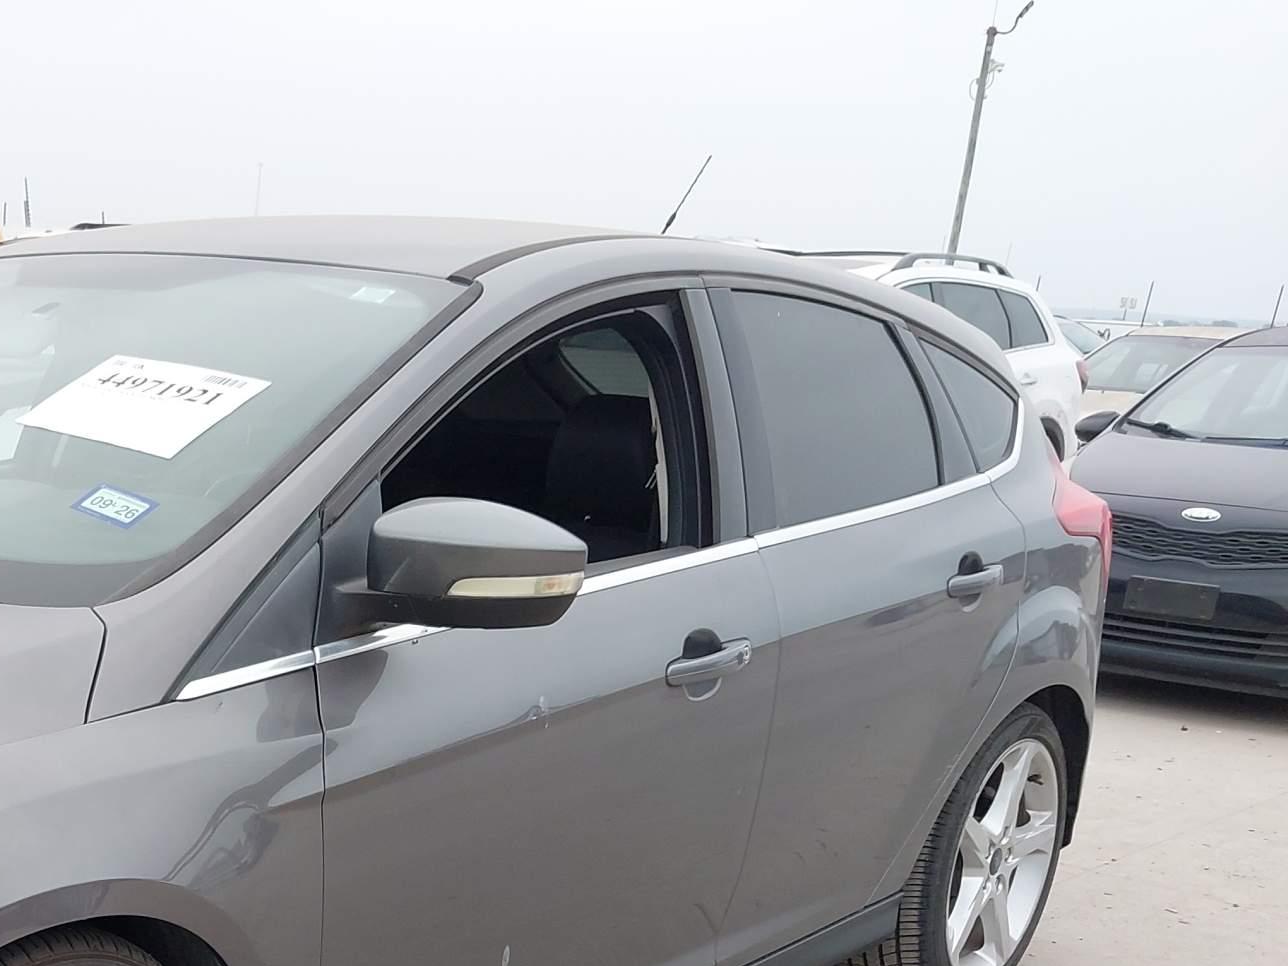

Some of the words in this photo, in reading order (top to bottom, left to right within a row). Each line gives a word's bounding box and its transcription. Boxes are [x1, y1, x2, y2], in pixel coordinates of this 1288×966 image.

[97, 372, 223, 405] 44971921
[90, 495, 113, 509] 09
[113, 505, 139, 519] 26
